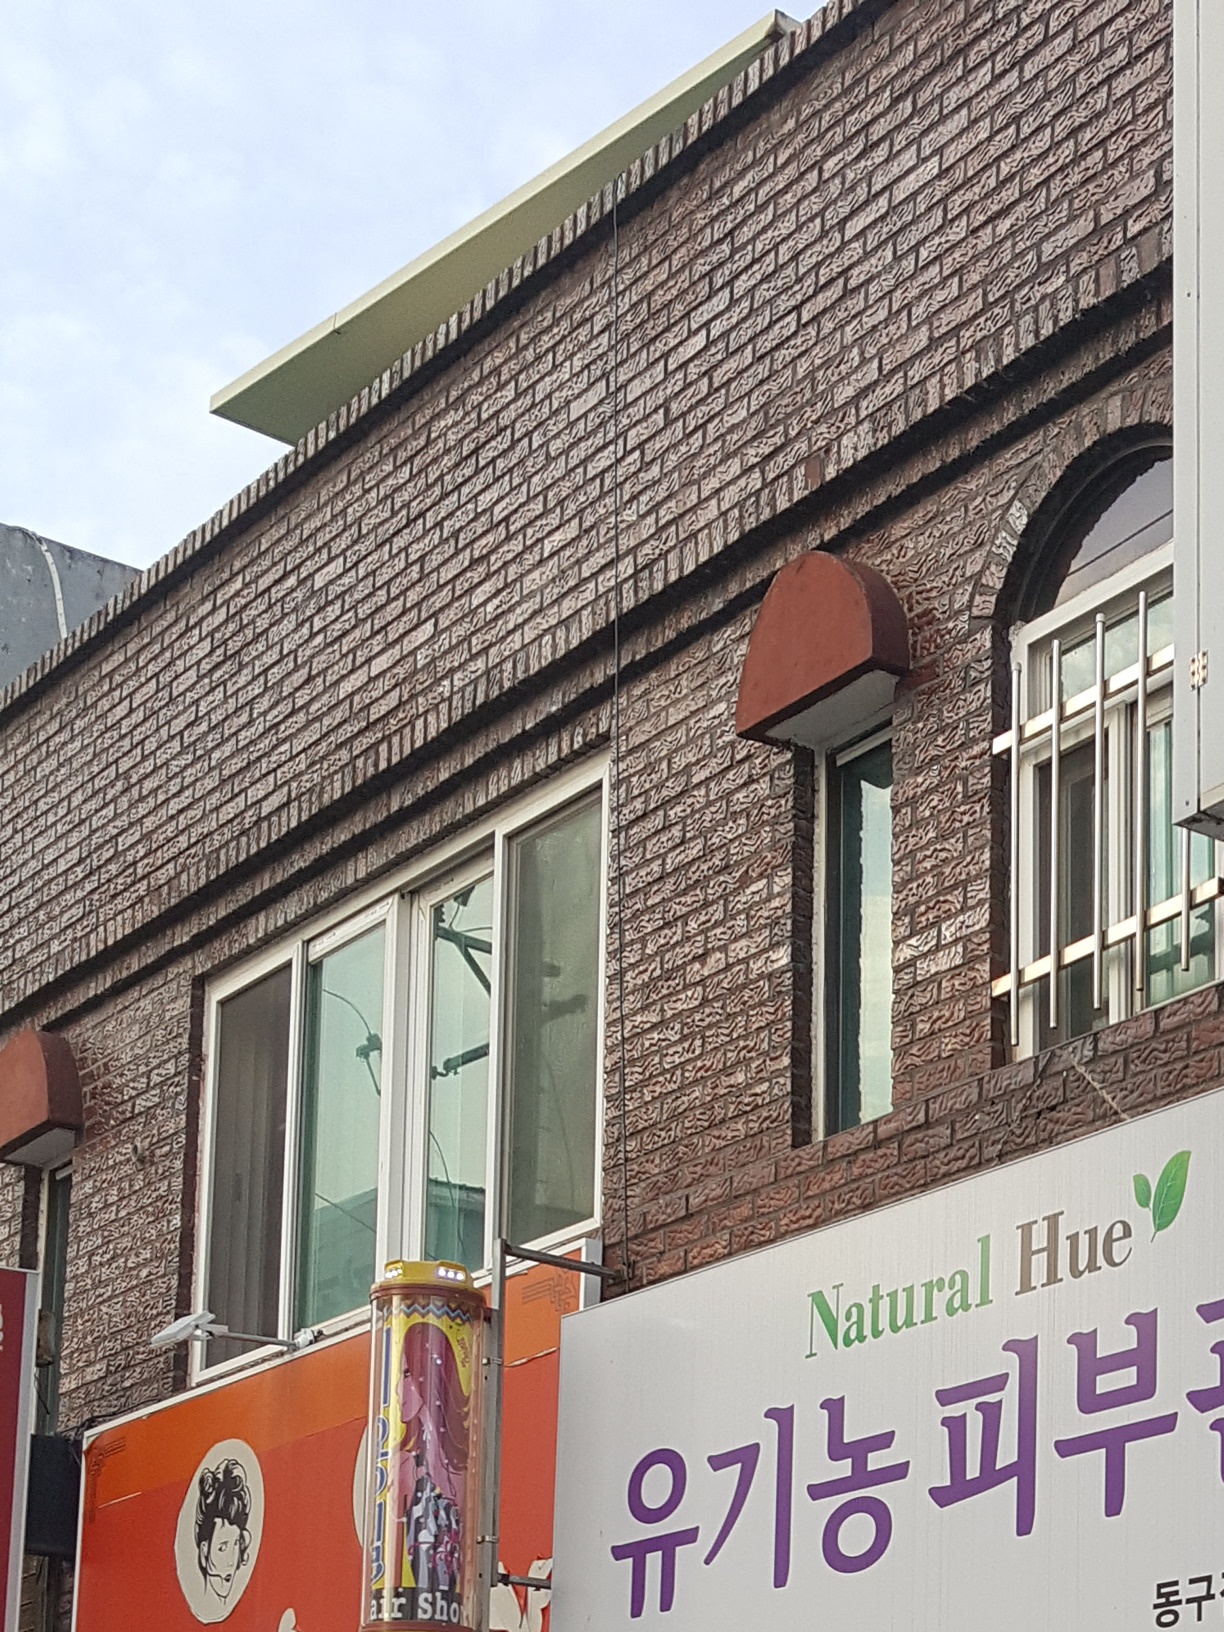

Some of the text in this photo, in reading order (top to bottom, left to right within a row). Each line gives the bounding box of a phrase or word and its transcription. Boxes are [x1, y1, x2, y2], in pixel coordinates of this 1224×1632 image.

[805, 1210, 1133, 1359] Natural Hue
[417, 1591, 464, 1624] Sho
